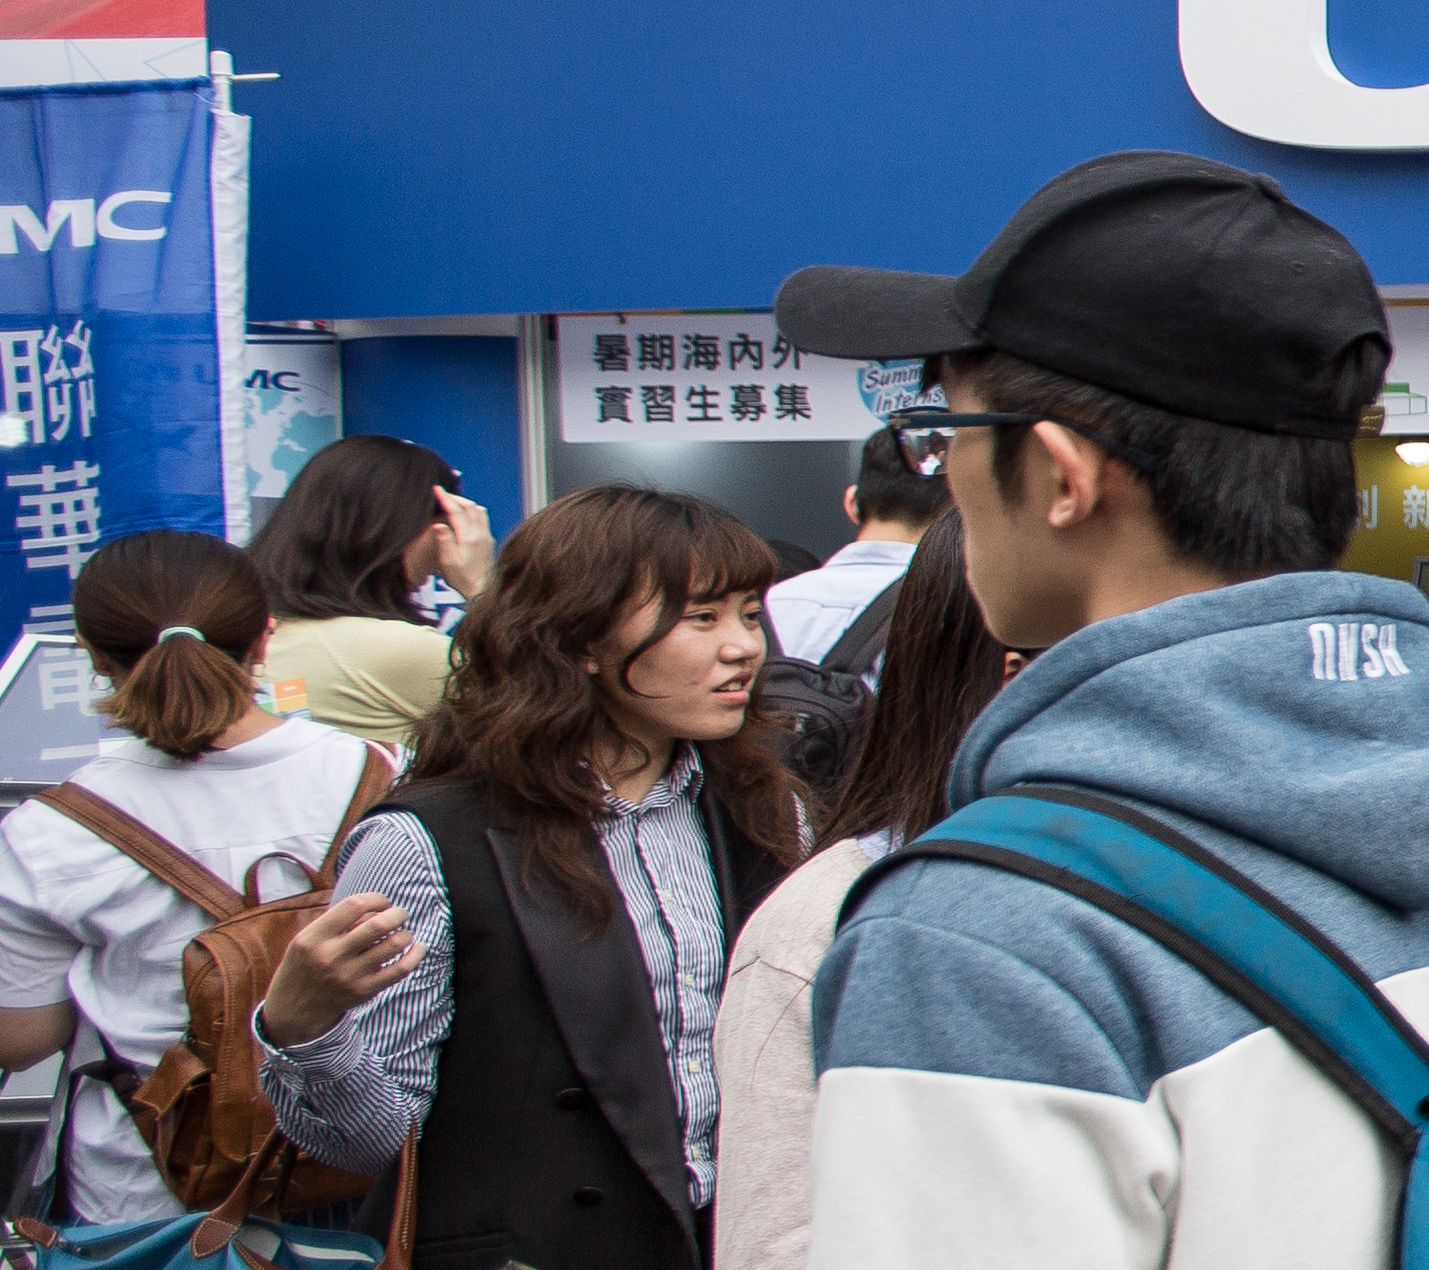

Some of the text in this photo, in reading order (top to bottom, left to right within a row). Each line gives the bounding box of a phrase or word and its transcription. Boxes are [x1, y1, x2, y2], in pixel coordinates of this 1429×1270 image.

[0, 190, 173, 254] MC
[244, 369, 302, 392] MC
[865, 369, 922, 390] Summ
[876, 389, 944, 413] Interns
